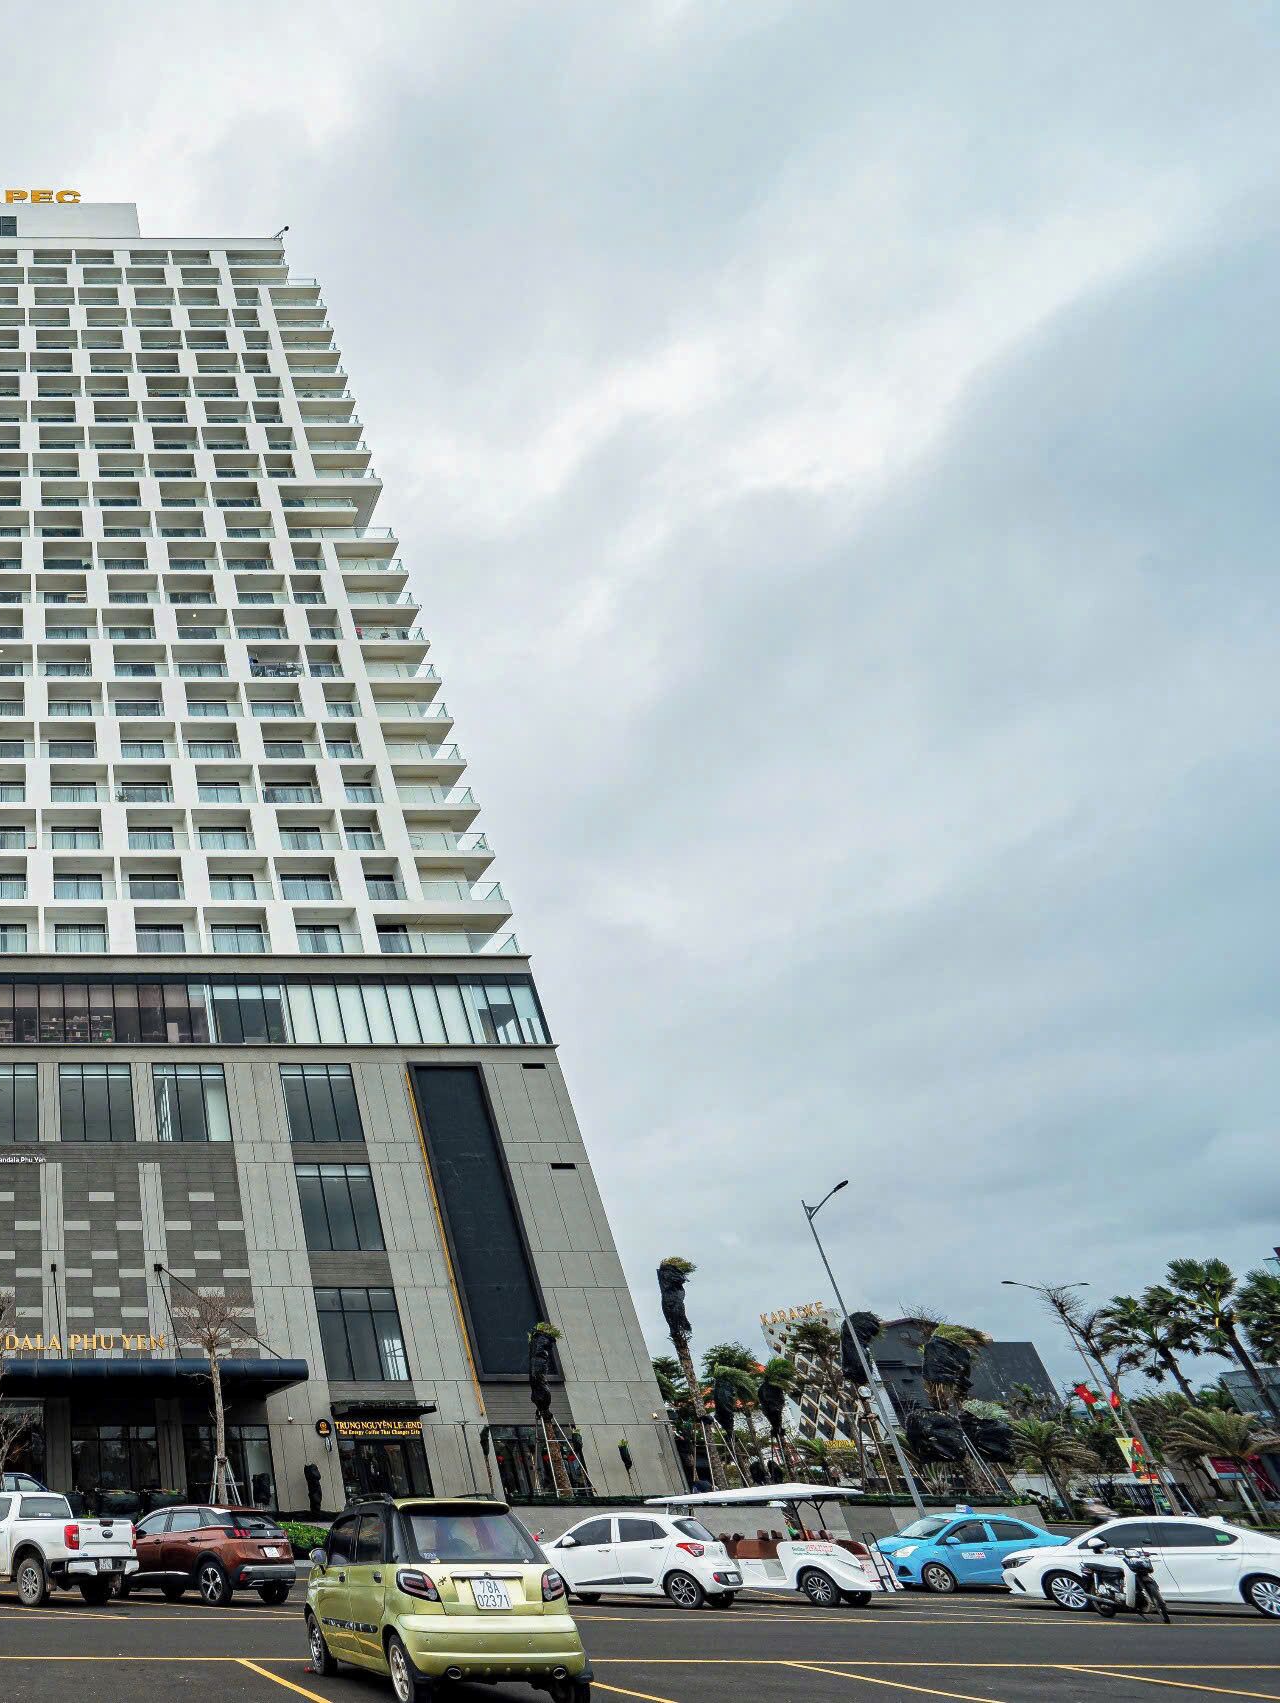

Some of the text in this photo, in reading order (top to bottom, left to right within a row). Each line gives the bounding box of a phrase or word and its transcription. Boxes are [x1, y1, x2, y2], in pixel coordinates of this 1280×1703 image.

[759, 1300, 826, 1326] KARAOKE
[69, 1334, 114, 1351] PHU
[120, 1334, 167, 1351] YEN
[334, 1421, 360, 1430] TRUNG
[393, 1421, 423, 1430] LEGEND
[479, 1580, 501, 1594] 78A
[477, 1594, 511, 1608] 023.71
